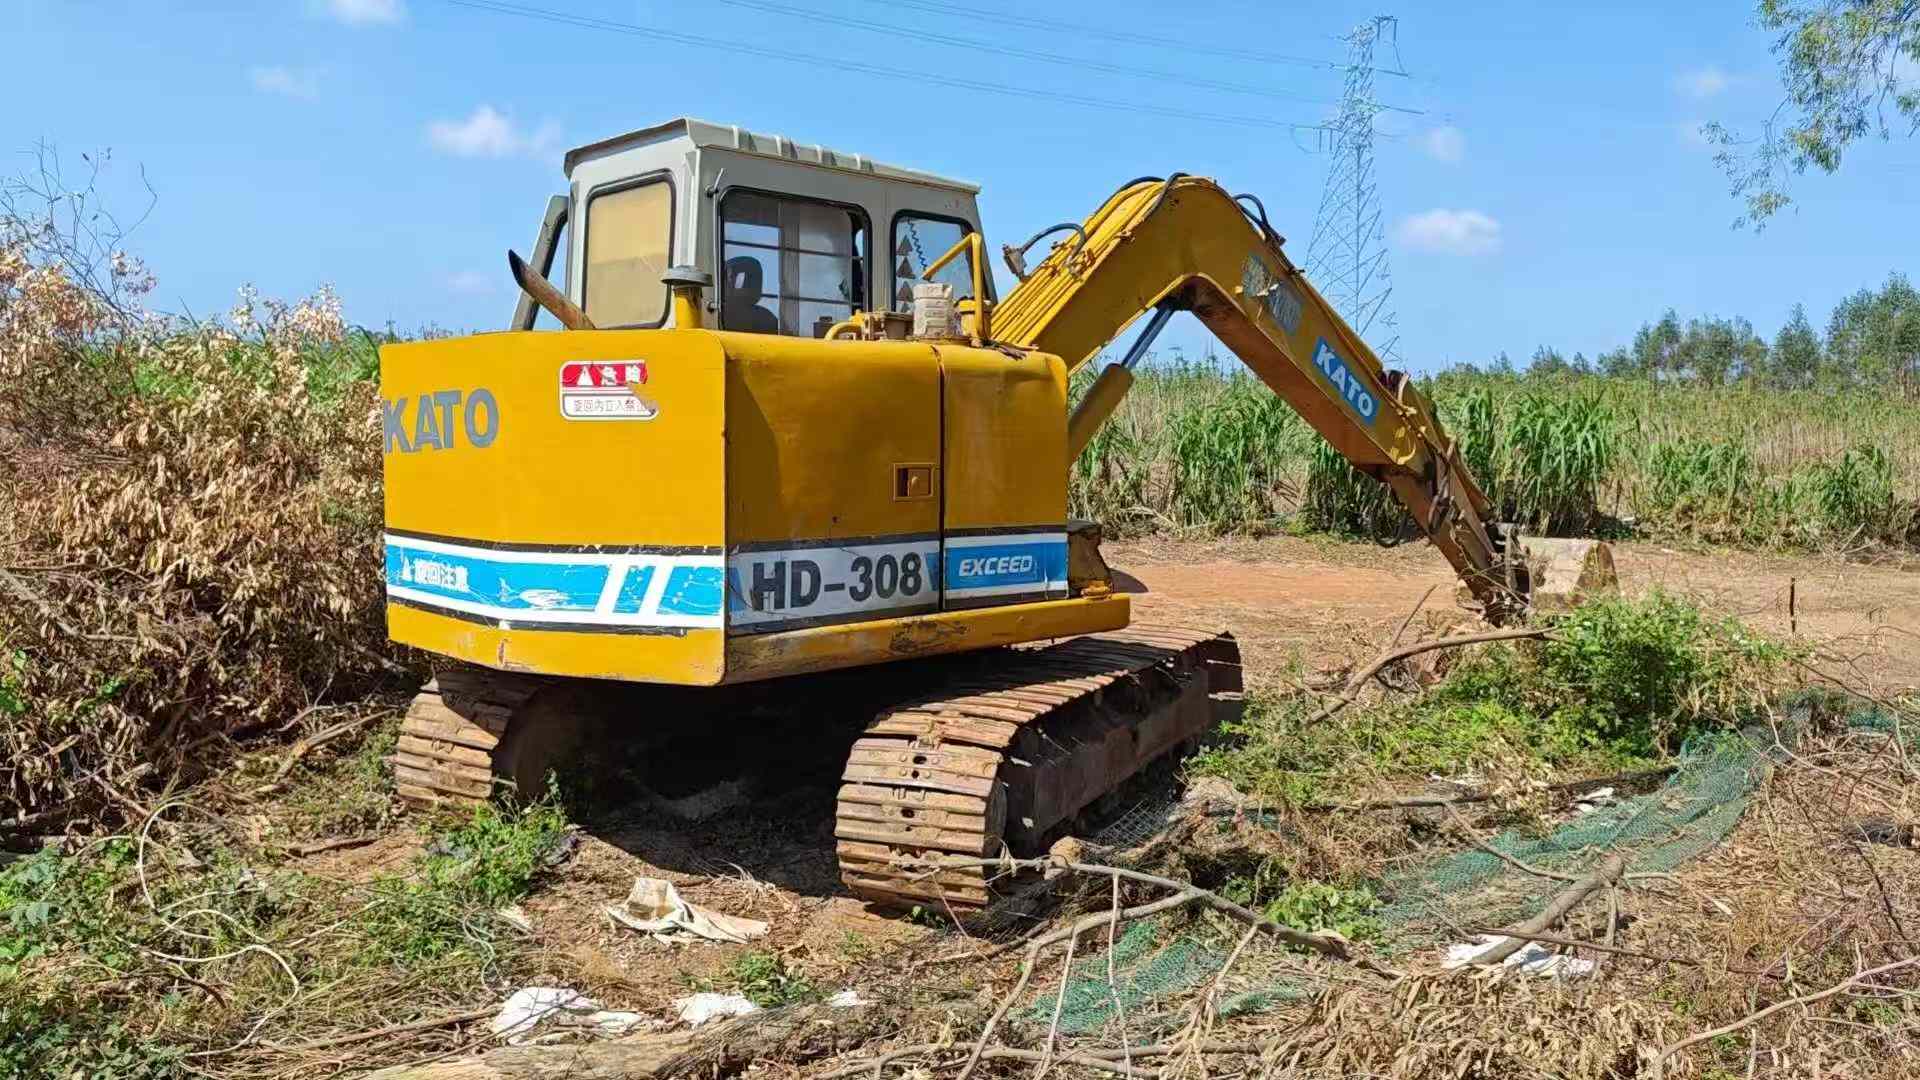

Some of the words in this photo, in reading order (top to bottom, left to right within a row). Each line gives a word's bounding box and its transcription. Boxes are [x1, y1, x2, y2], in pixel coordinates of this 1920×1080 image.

[1315, 343, 1373, 417] KATO
[384, 388, 499, 453] KATO
[751, 551, 922, 612] HD-308
[959, 555, 1033, 577] EXCEED
